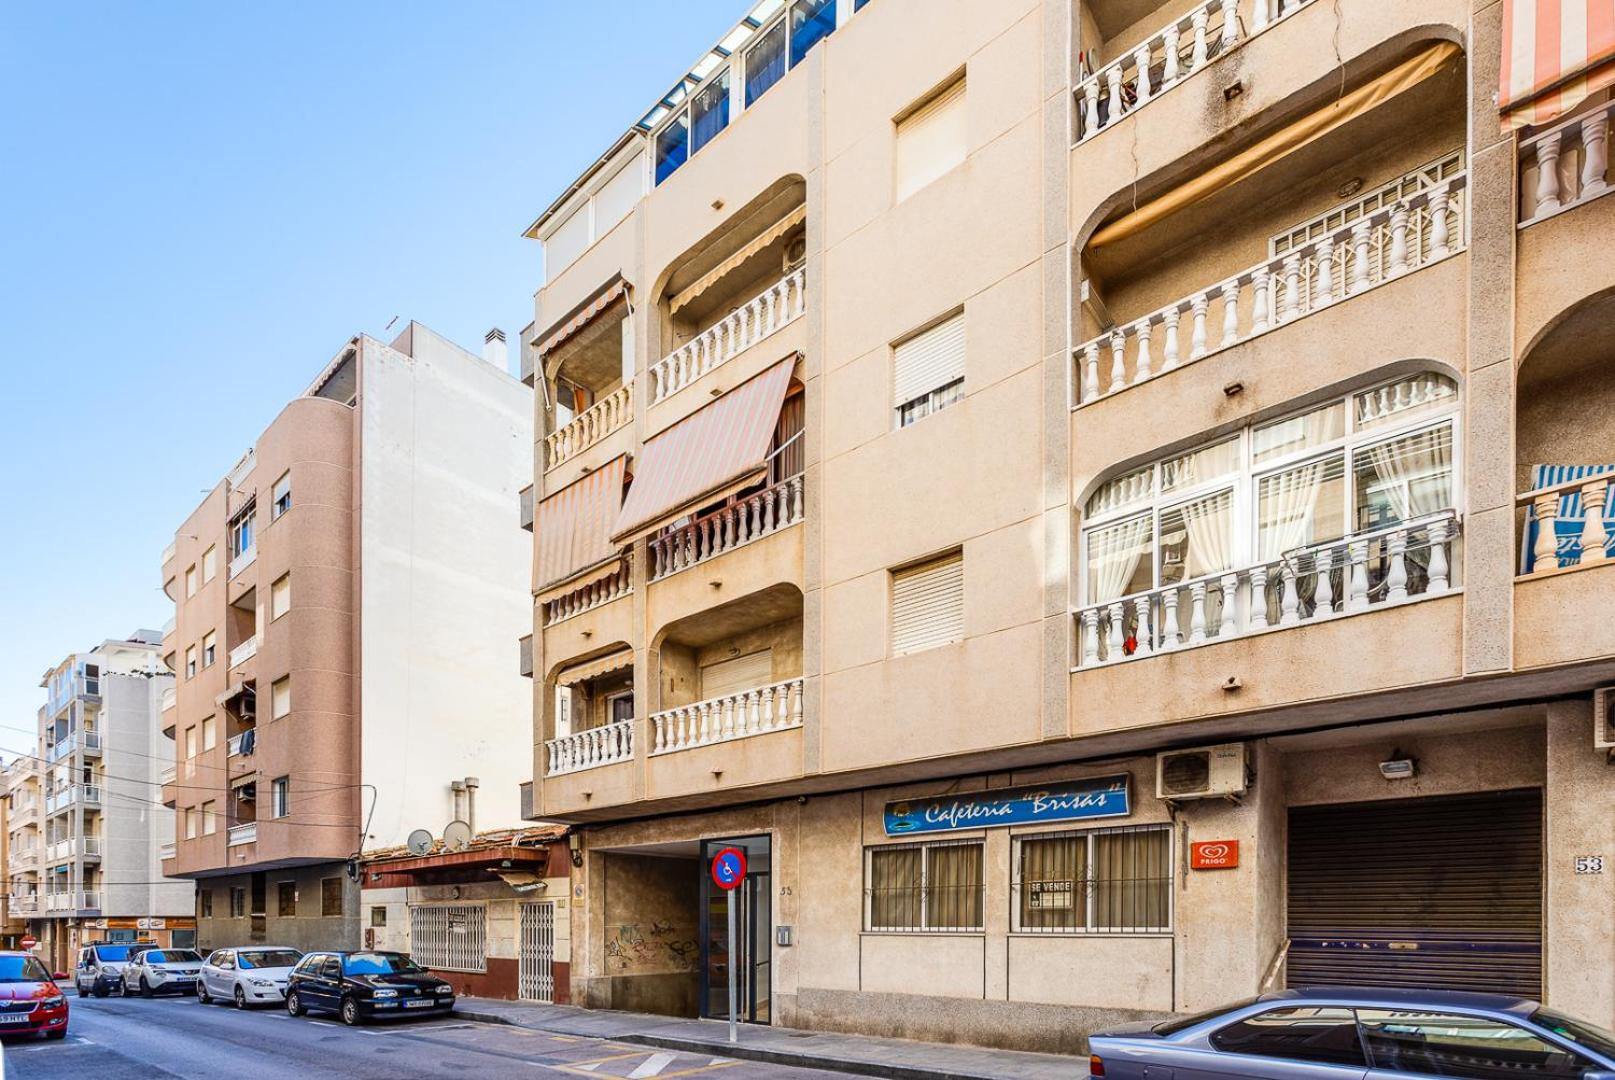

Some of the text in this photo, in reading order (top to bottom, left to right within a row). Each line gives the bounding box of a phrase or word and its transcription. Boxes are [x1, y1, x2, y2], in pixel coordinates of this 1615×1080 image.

[1577, 857, 1602, 871] 53
[1031, 882, 1071, 892] SE VENDE
